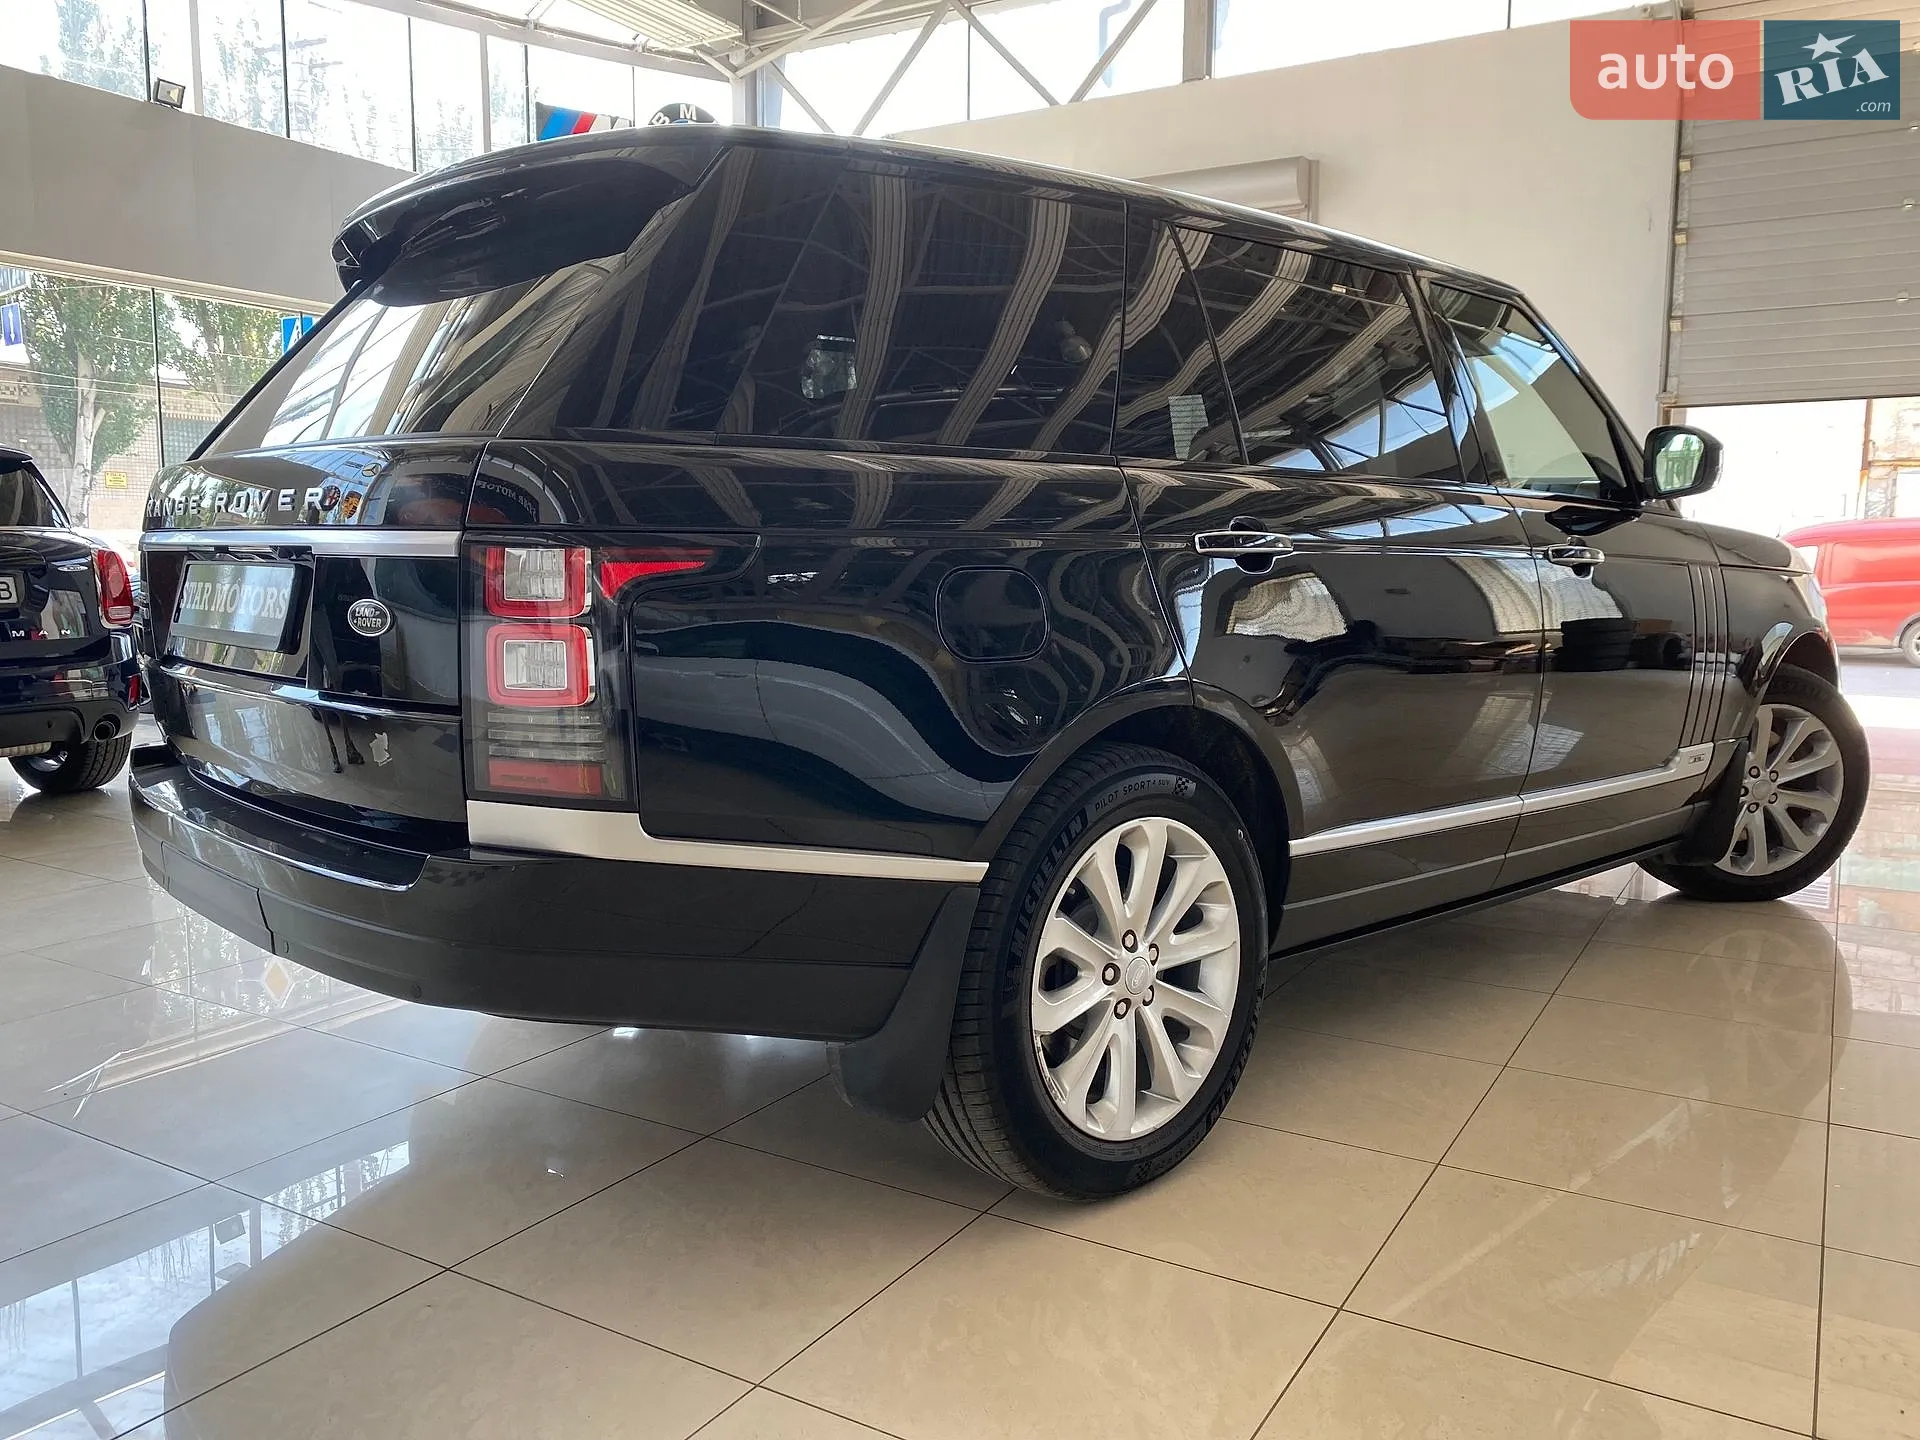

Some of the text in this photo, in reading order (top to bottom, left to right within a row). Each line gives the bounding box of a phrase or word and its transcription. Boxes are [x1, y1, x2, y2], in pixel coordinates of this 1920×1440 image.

[146, 488, 324, 517] RANGE ROVER
[180, 581, 288, 619] STAR MOTORS
[354, 606, 375, 617] LAND
[357, 617, 381, 628] ROVER
[1095, 790, 1119, 812] PILOT
[1122, 779, 1151, 796] SPORT
[1010, 813, 1085, 961] MICHELIN
